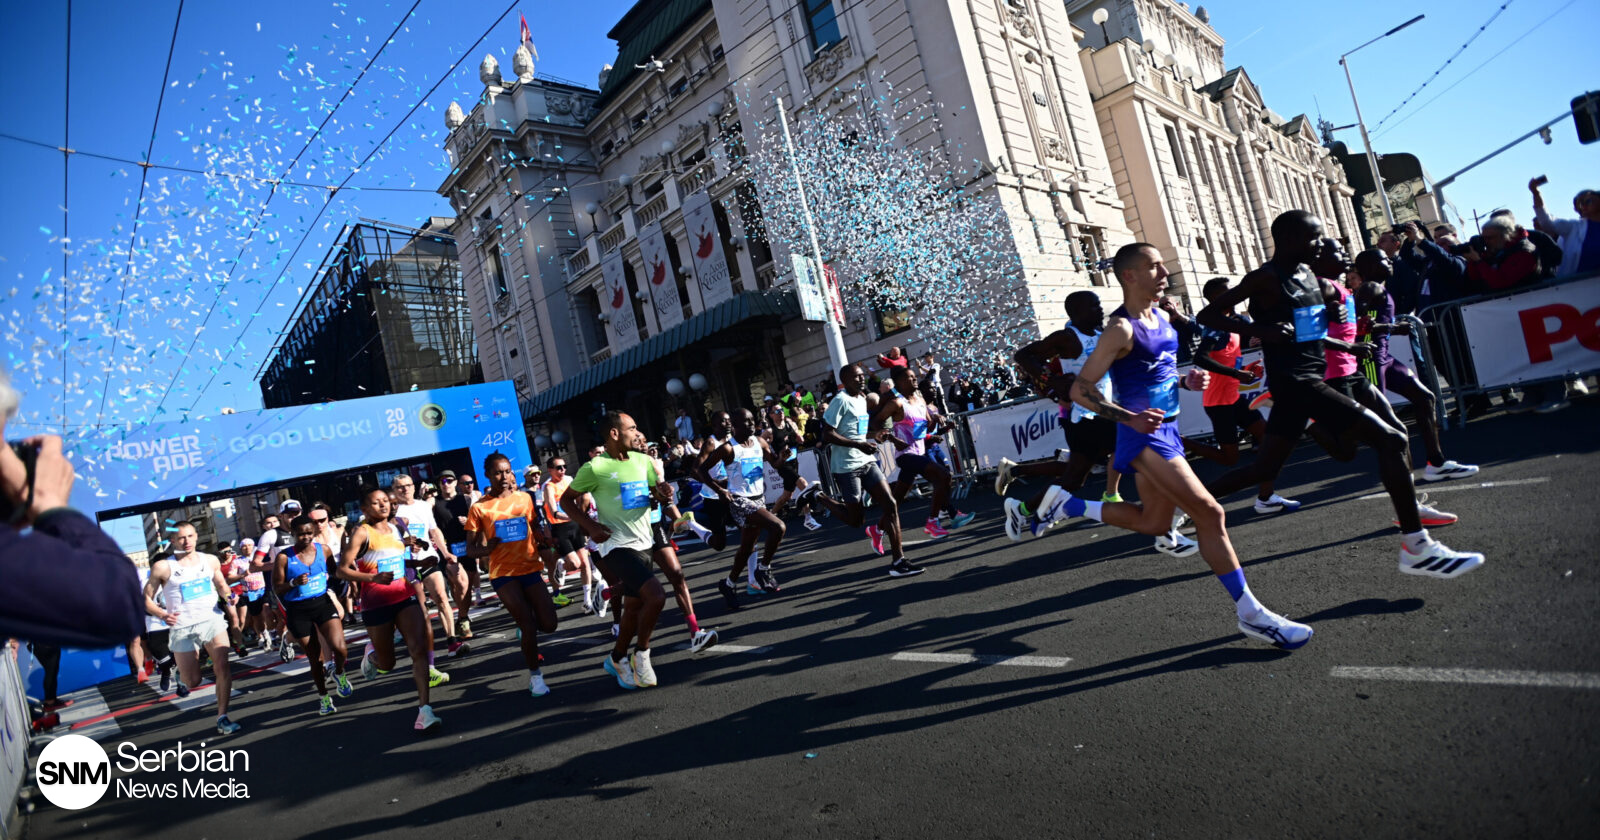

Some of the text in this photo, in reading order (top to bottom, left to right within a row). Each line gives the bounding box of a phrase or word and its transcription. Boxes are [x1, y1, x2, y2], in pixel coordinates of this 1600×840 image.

[385, 407, 405, 423] 20
[229, 418, 372, 454] GOOD LUCK!
[388, 422, 408, 437] 26
[481, 429, 515, 447] 42K
[104, 434, 201, 463] POWER
[153, 451, 205, 473] ADE
